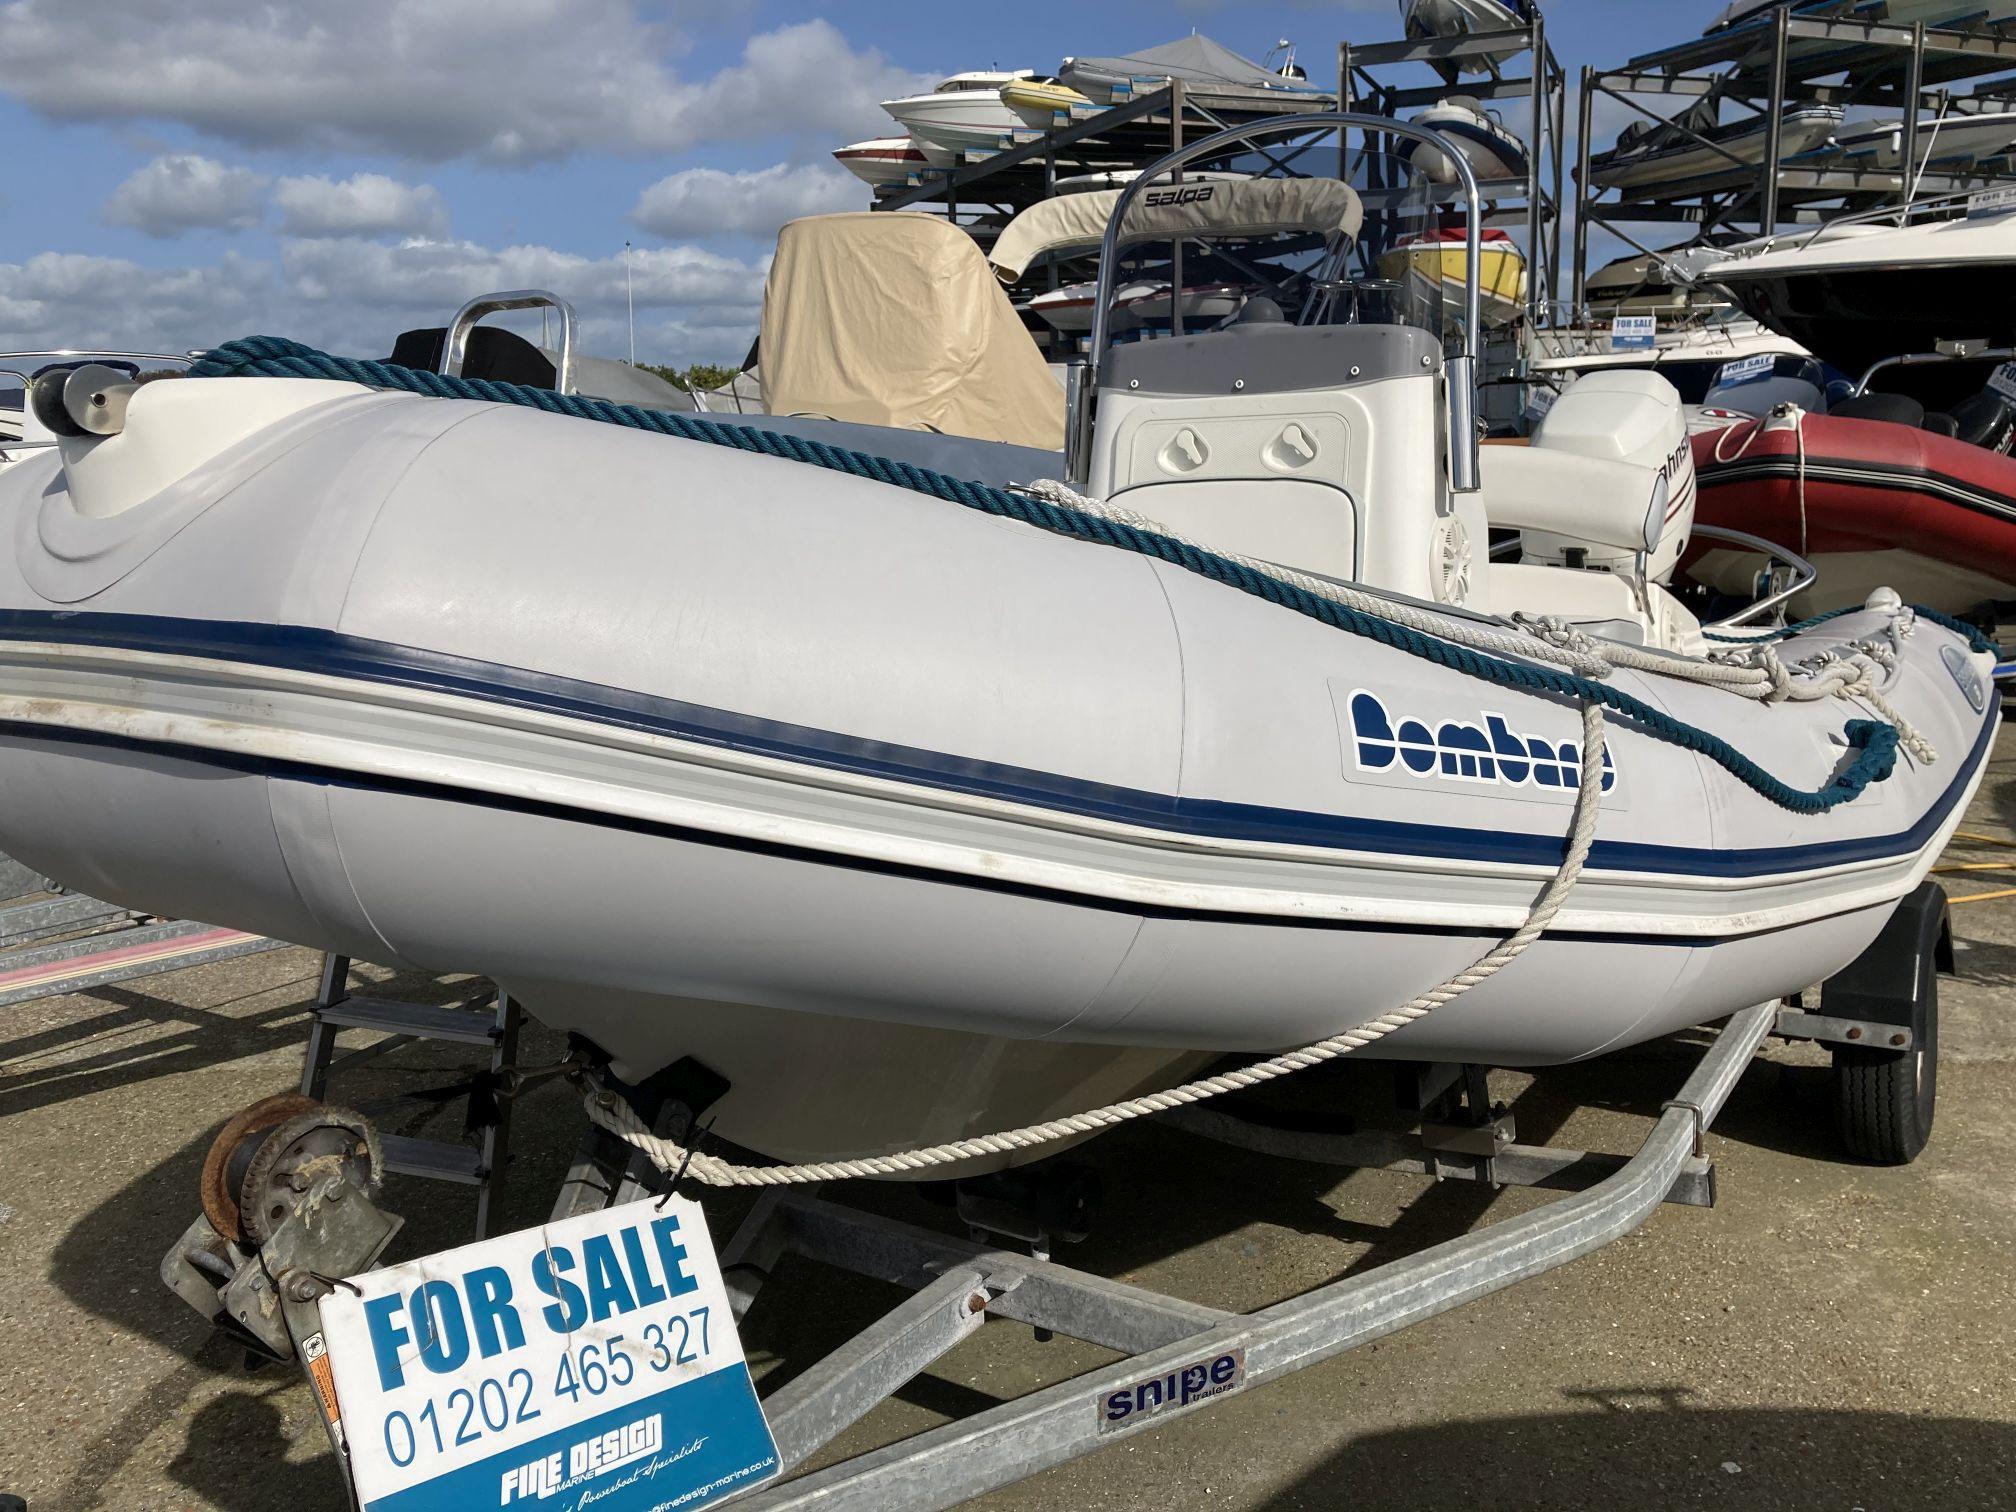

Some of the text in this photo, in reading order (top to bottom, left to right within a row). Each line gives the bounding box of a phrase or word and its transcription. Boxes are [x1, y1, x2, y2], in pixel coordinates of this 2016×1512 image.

[1145, 187, 1214, 207] salpa
[1616, 318, 1652, 328] FOR SALE
[1748, 357, 1770, 367] SALE
[363, 1265, 527, 1393] FOR
[531, 1215, 699, 1334] SALE
[384, 1367, 541, 1467] 01202
[554, 1335, 634, 1404] 465
[643, 1306, 712, 1372] 327
[1107, 1355, 1235, 1421] snipe
[1193, 1382, 1234, 1402] trailers
[500, 1413, 662, 1506] FINE DESIGN
[578, 1436, 709, 1512] Powerboat Specialists
[556, 1471, 595, 1494] MARINE
